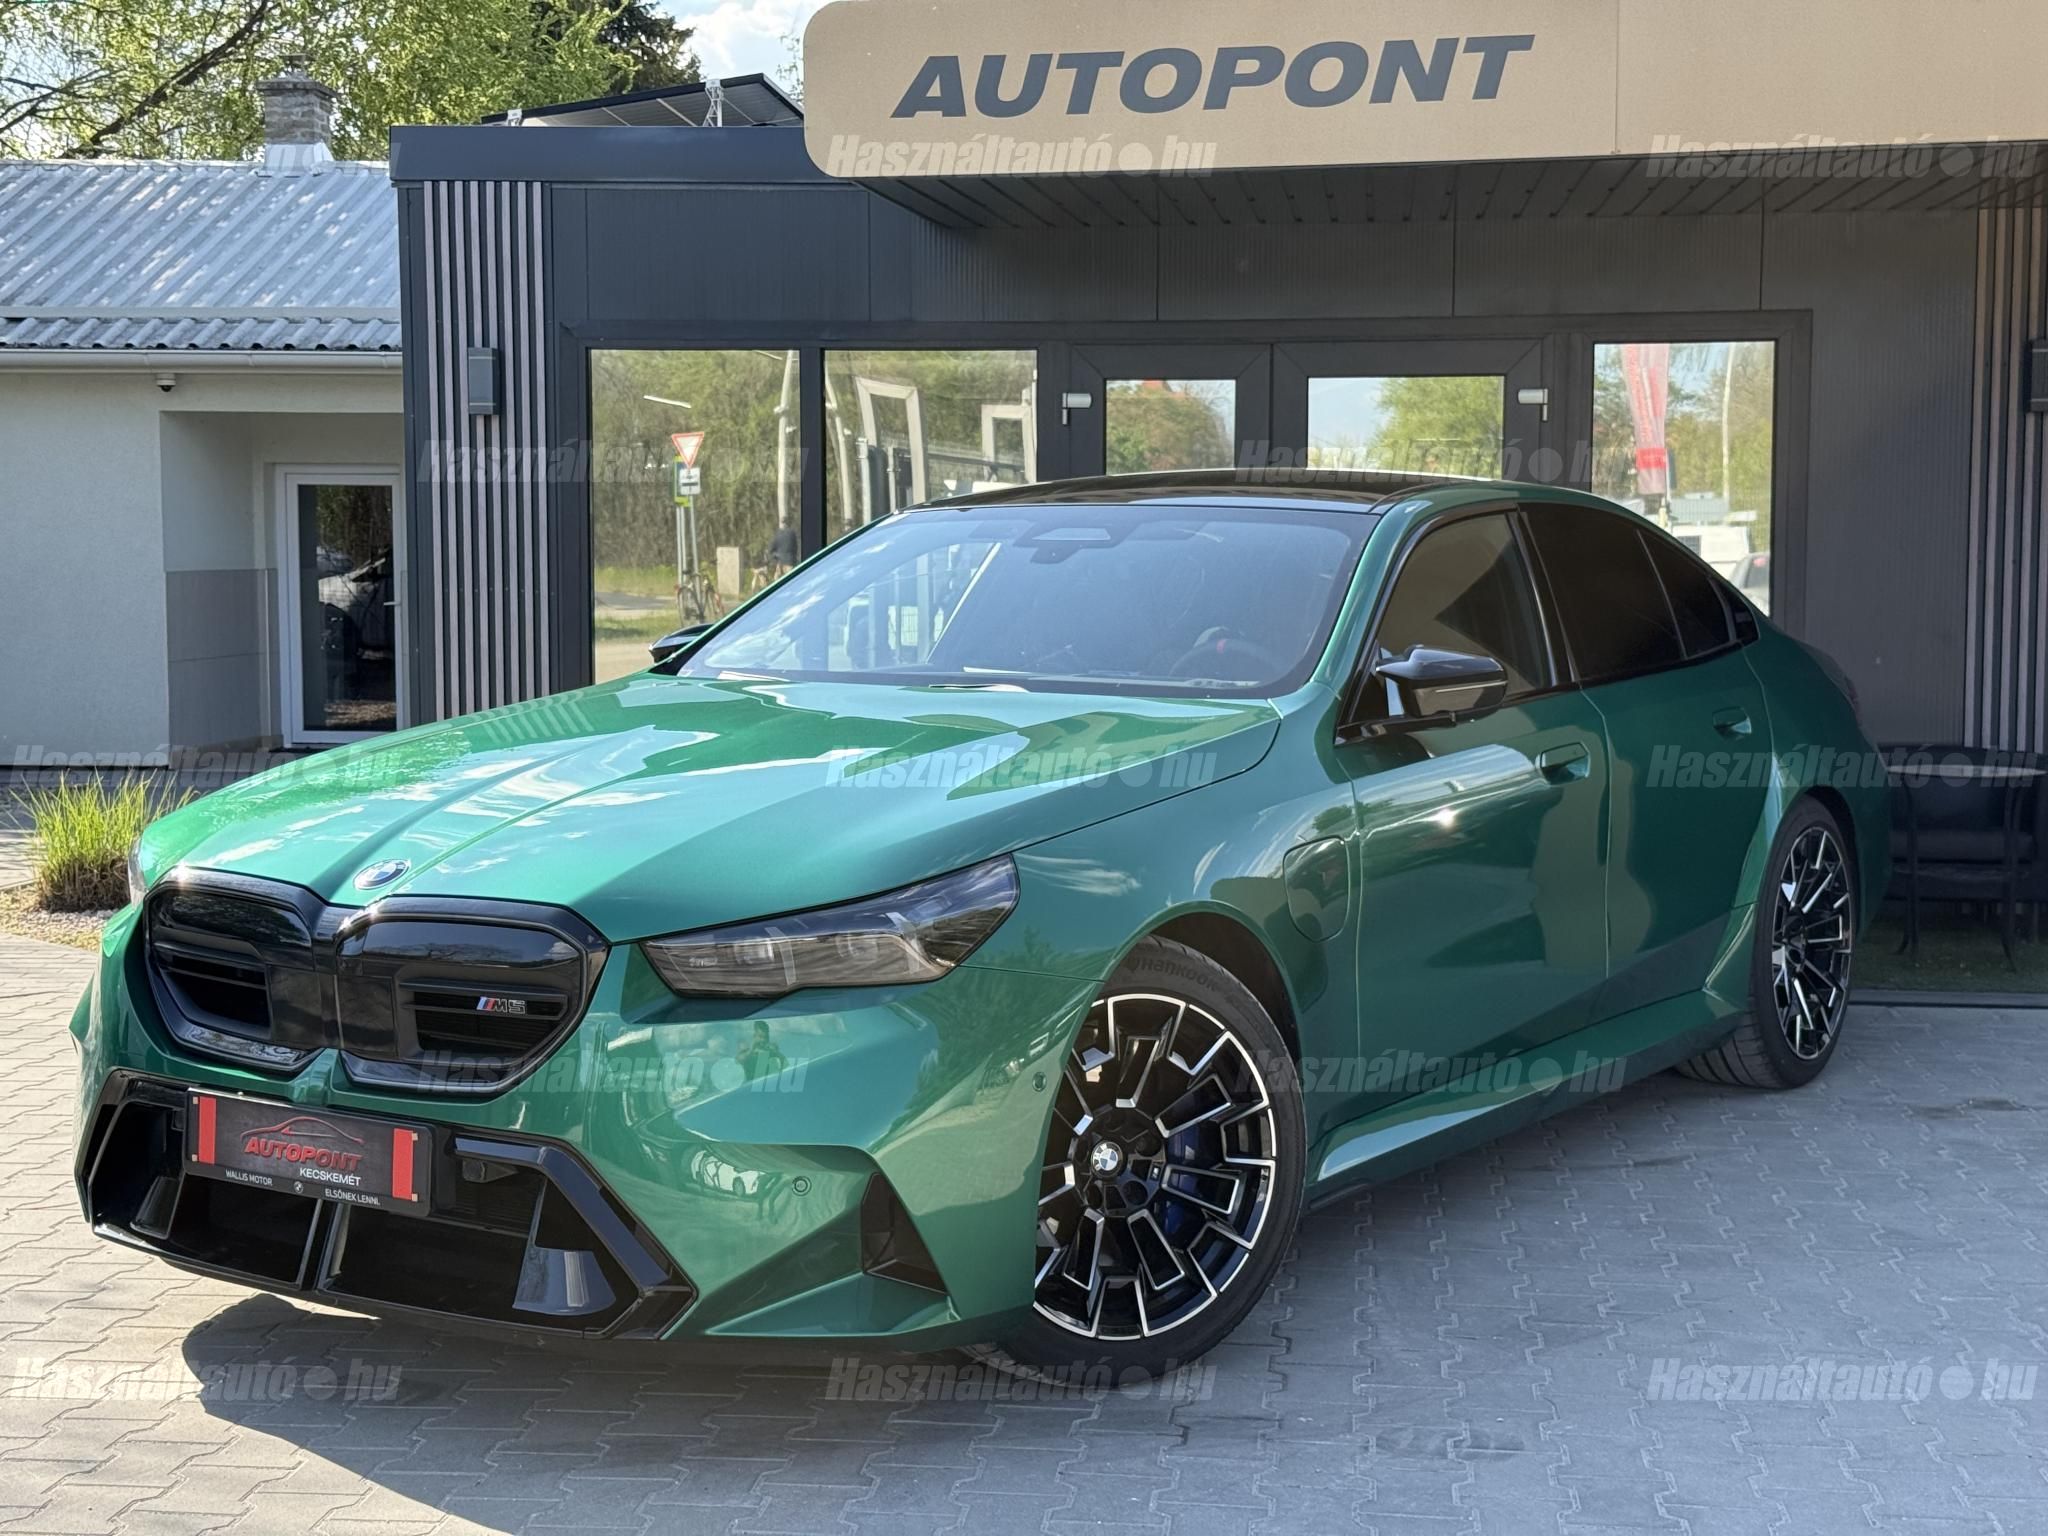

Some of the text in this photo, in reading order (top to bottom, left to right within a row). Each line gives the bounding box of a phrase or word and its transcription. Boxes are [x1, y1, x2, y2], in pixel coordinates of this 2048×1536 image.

[891, 35, 1533, 118] AUTOPONT
[244, 1136, 363, 1171] AUTOPONT
[225, 1169, 273, 1187] WALLIS MOTOR
[299, 1167, 361, 1187] KECSKEMÉT
